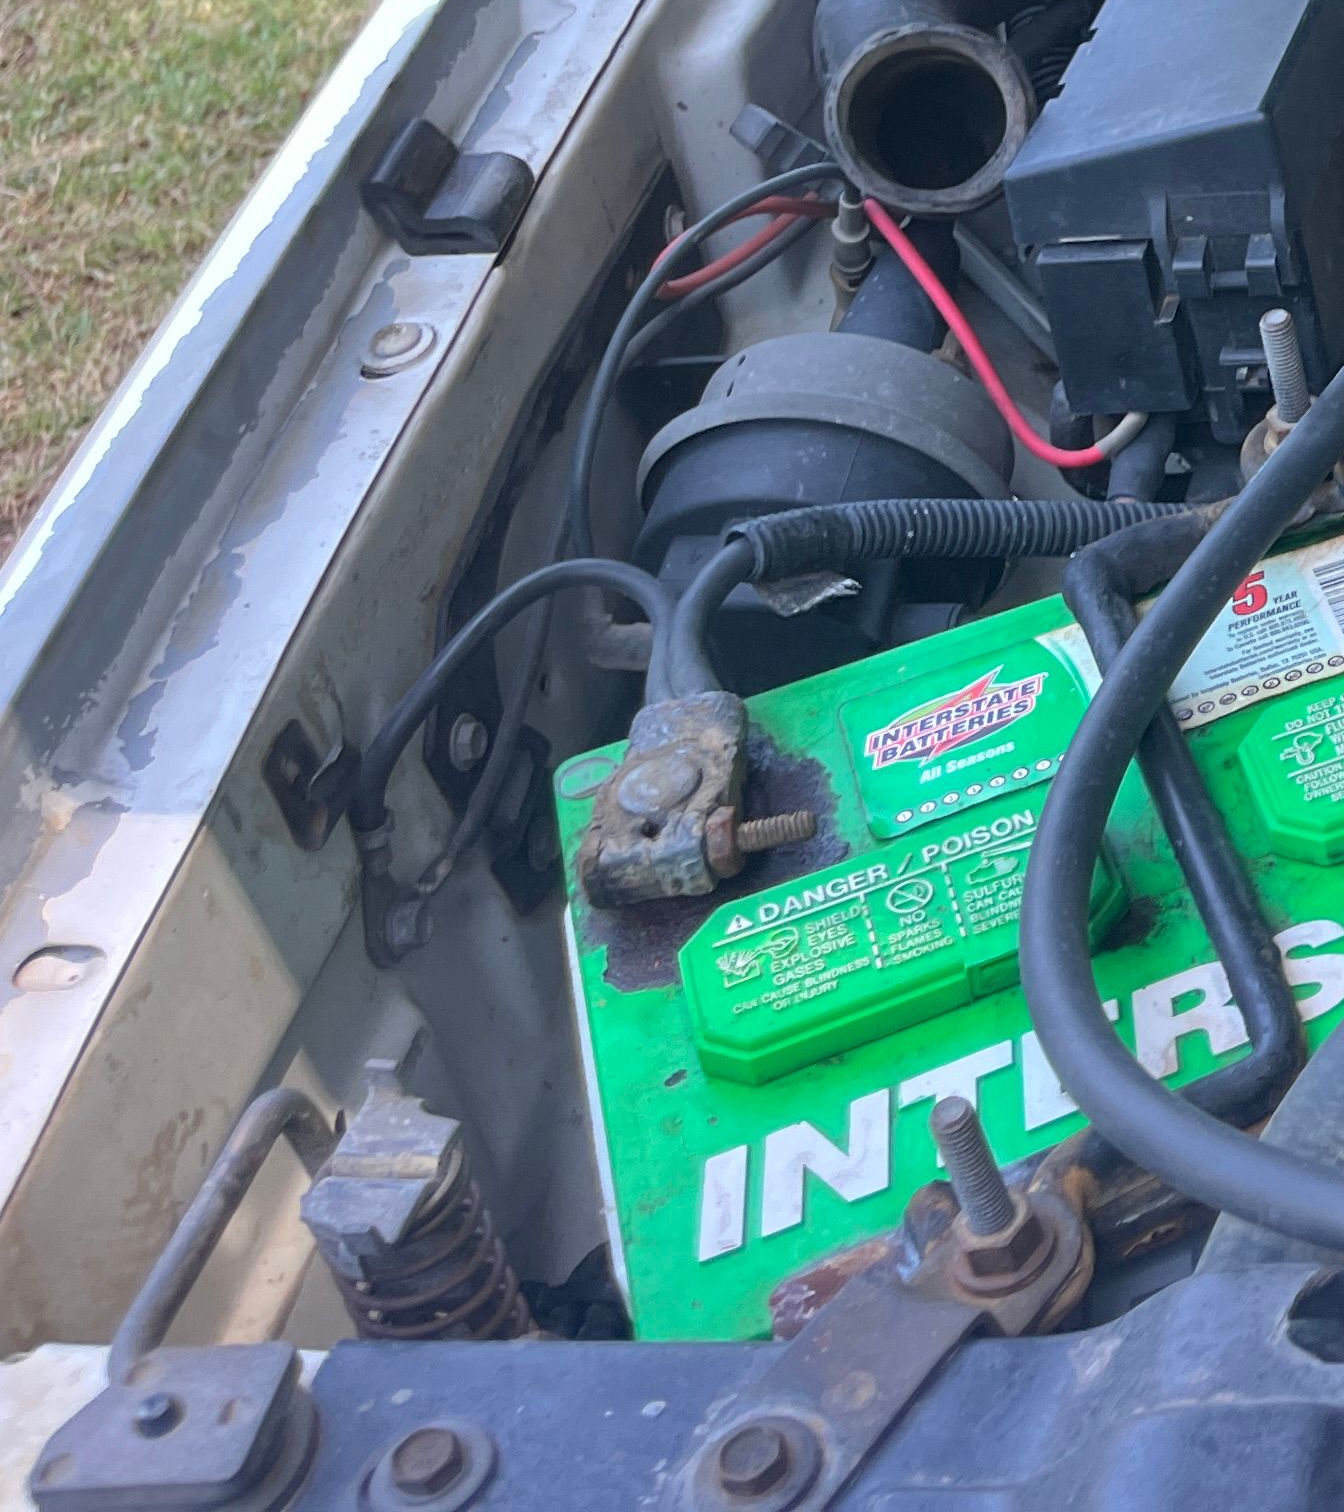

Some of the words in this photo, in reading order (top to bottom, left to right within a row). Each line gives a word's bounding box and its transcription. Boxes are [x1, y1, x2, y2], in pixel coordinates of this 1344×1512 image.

[1232, 570, 1269, 616] 5
[1272, 590, 1298, 605] YEAR
[1228, 598, 1302, 631] PERFORMANCE
[868, 674, 1043, 752] INTERSTATE
[1284, 716, 1304, 733] DO
[1305, 708, 1334, 728] NOT
[1306, 695, 1337, 716] KEEP
[877, 695, 1035, 766] BATTERIES
[919, 764, 943, 785] All
[945, 741, 1016, 775] Seasons
[758, 862, 891, 925] DANGER
[920, 807, 1036, 865] POISON
[963, 871, 1028, 904] SULFUR
[965, 895, 995, 916] CAN
[997, 885, 1024, 906] CAU
[804, 903, 861, 936] SHIELD
[898, 908, 929, 929] NO
[968, 899, 1023, 928] BLINDN
[807, 922, 850, 948] EYES
[887, 917, 943, 946] SPARKS
[888, 927, 945, 957] FLAMES
[769, 933, 858, 975] EXPLOSIVE
[891, 936, 956, 968] SMOKING
[732, 998, 759, 1016] CAN
[761, 982, 803, 1005] CAUSE
[803, 955, 872, 990] BLINDNESS
[772, 958, 827, 987] GASES
[771, 995, 793, 1013] OR
[794, 978, 840, 1005] INJURY
